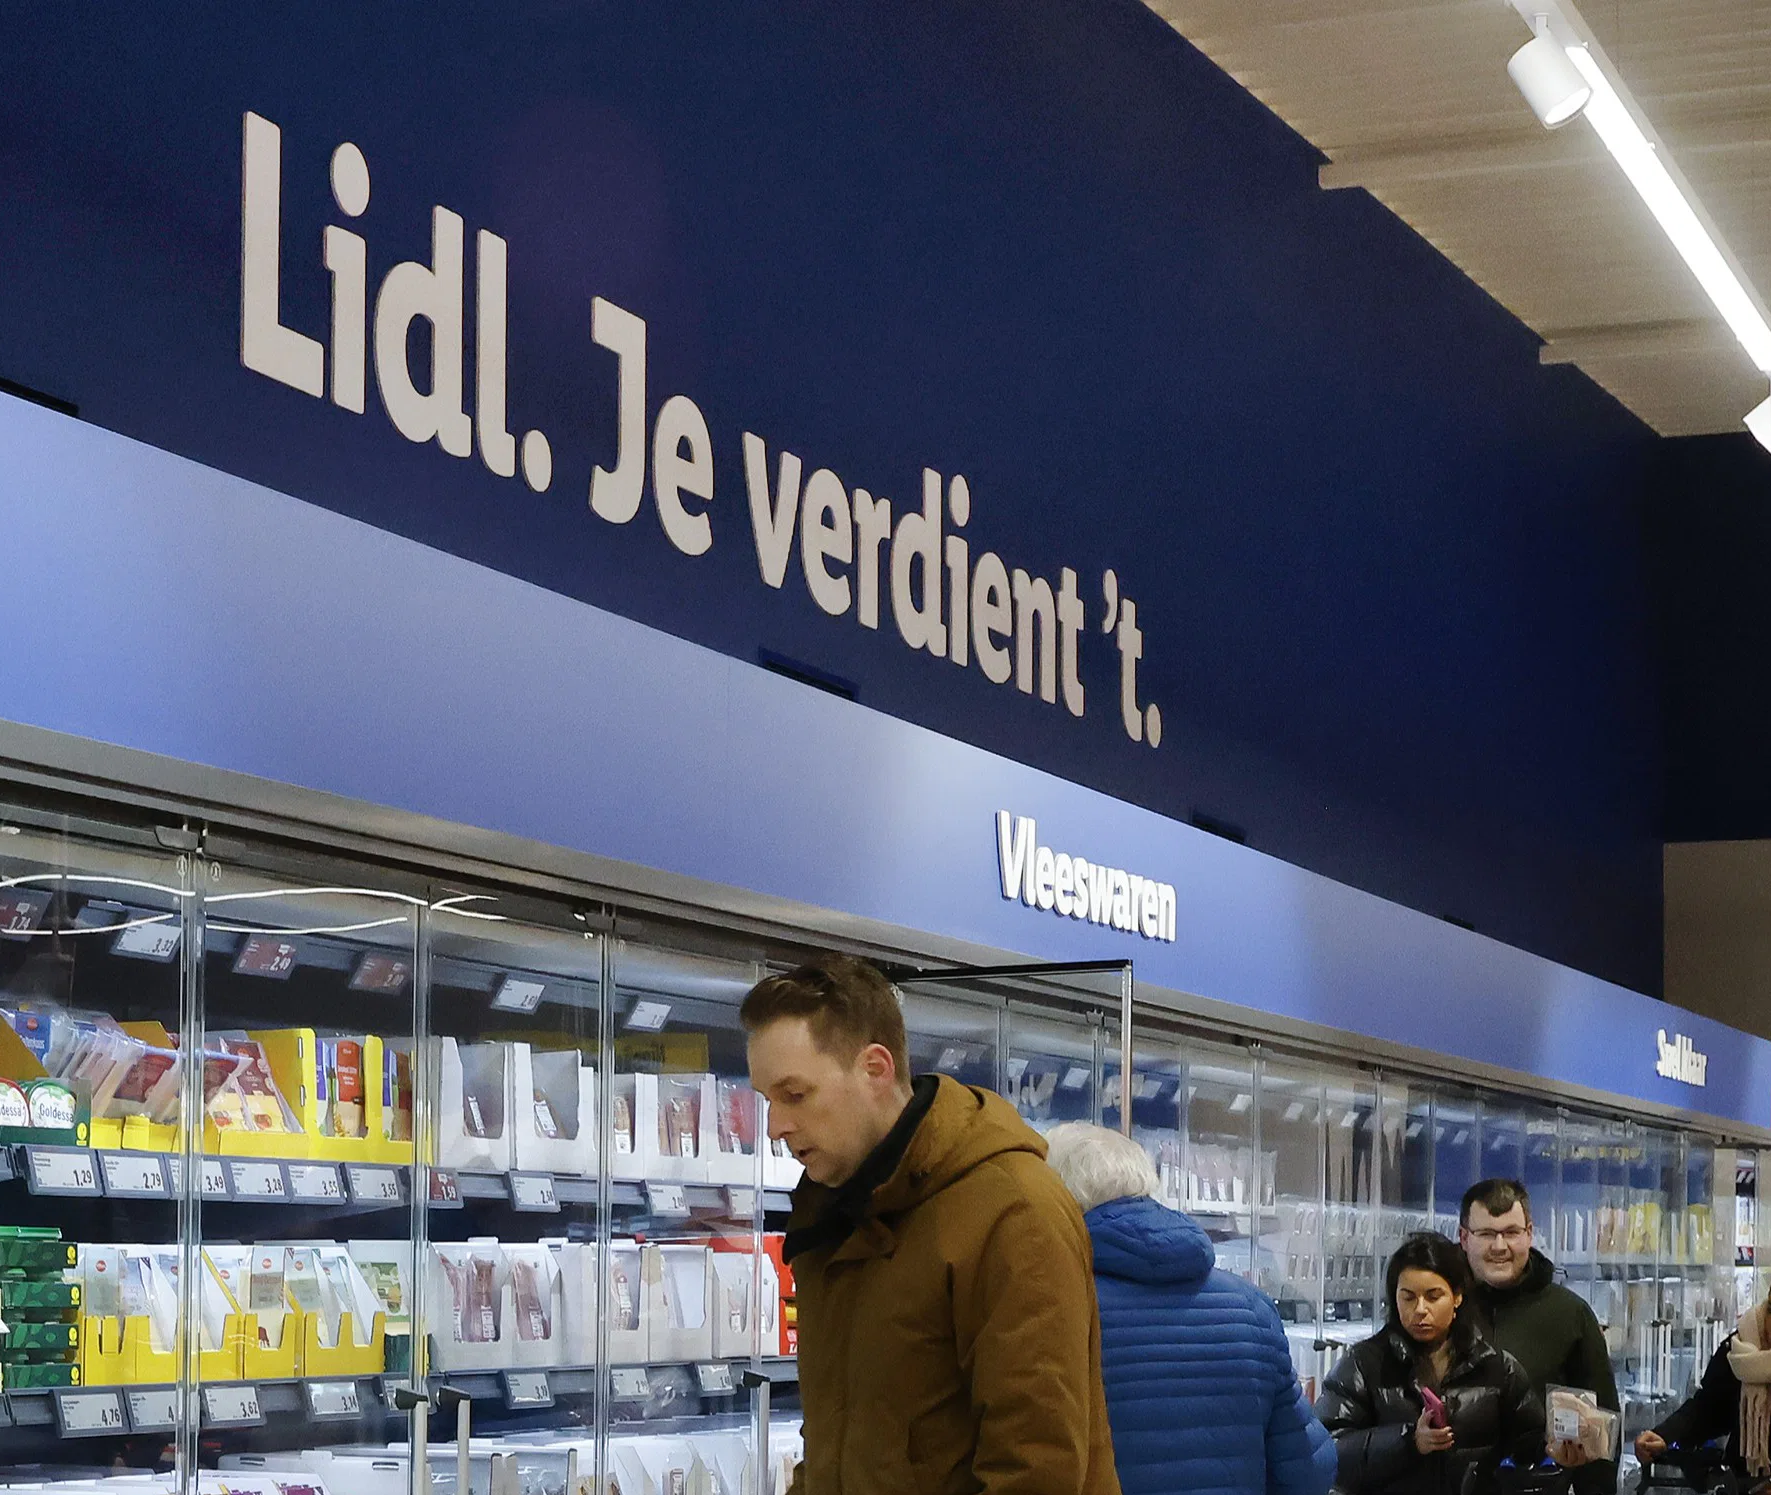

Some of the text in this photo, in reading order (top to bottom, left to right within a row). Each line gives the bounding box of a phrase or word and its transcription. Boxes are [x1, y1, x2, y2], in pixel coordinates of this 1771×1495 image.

[241, 110, 1164, 749] Lidl. Je verdient 't.
[996, 809, 1177, 943] Vleeswaren
[38, 1102, 74, 1122] Goldessa
[72, 1169, 93, 1189] 1.29
[141, 1172, 163, 1191] 2.79
[264, 1177, 284, 1194] 3.28
[101, 1407, 121, 1425] 4.76
